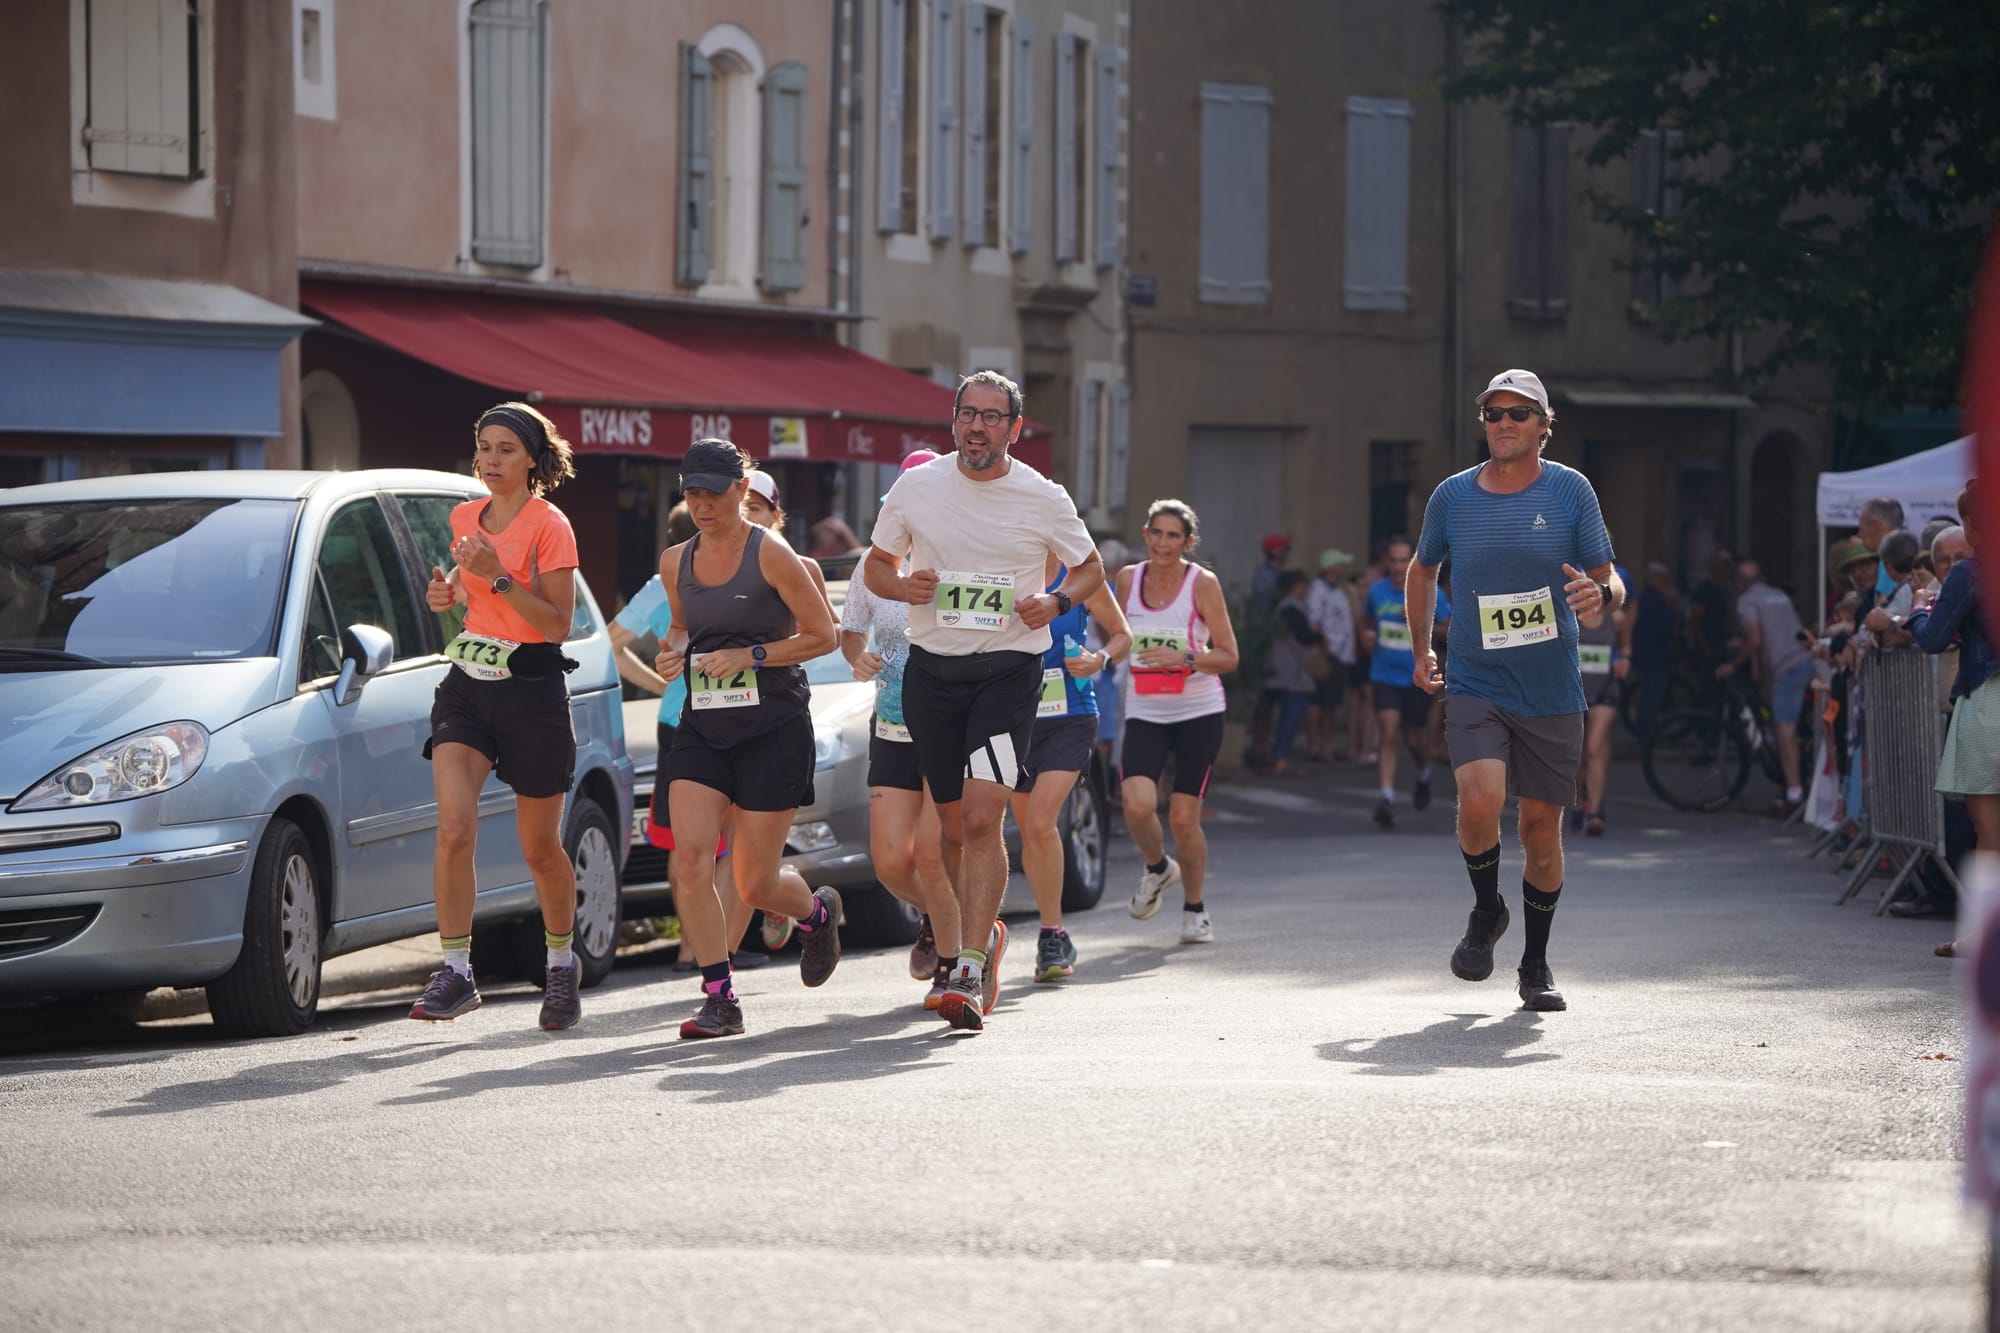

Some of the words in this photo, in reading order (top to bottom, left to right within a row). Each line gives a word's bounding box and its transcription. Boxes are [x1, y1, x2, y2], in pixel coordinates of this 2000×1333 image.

[580, 408, 652, 445] RYAN'S
[691, 414, 732, 443] BAR
[948, 586, 1002, 612] 174
[1491, 604, 1546, 630] 194
[457, 641, 501, 665] 173
